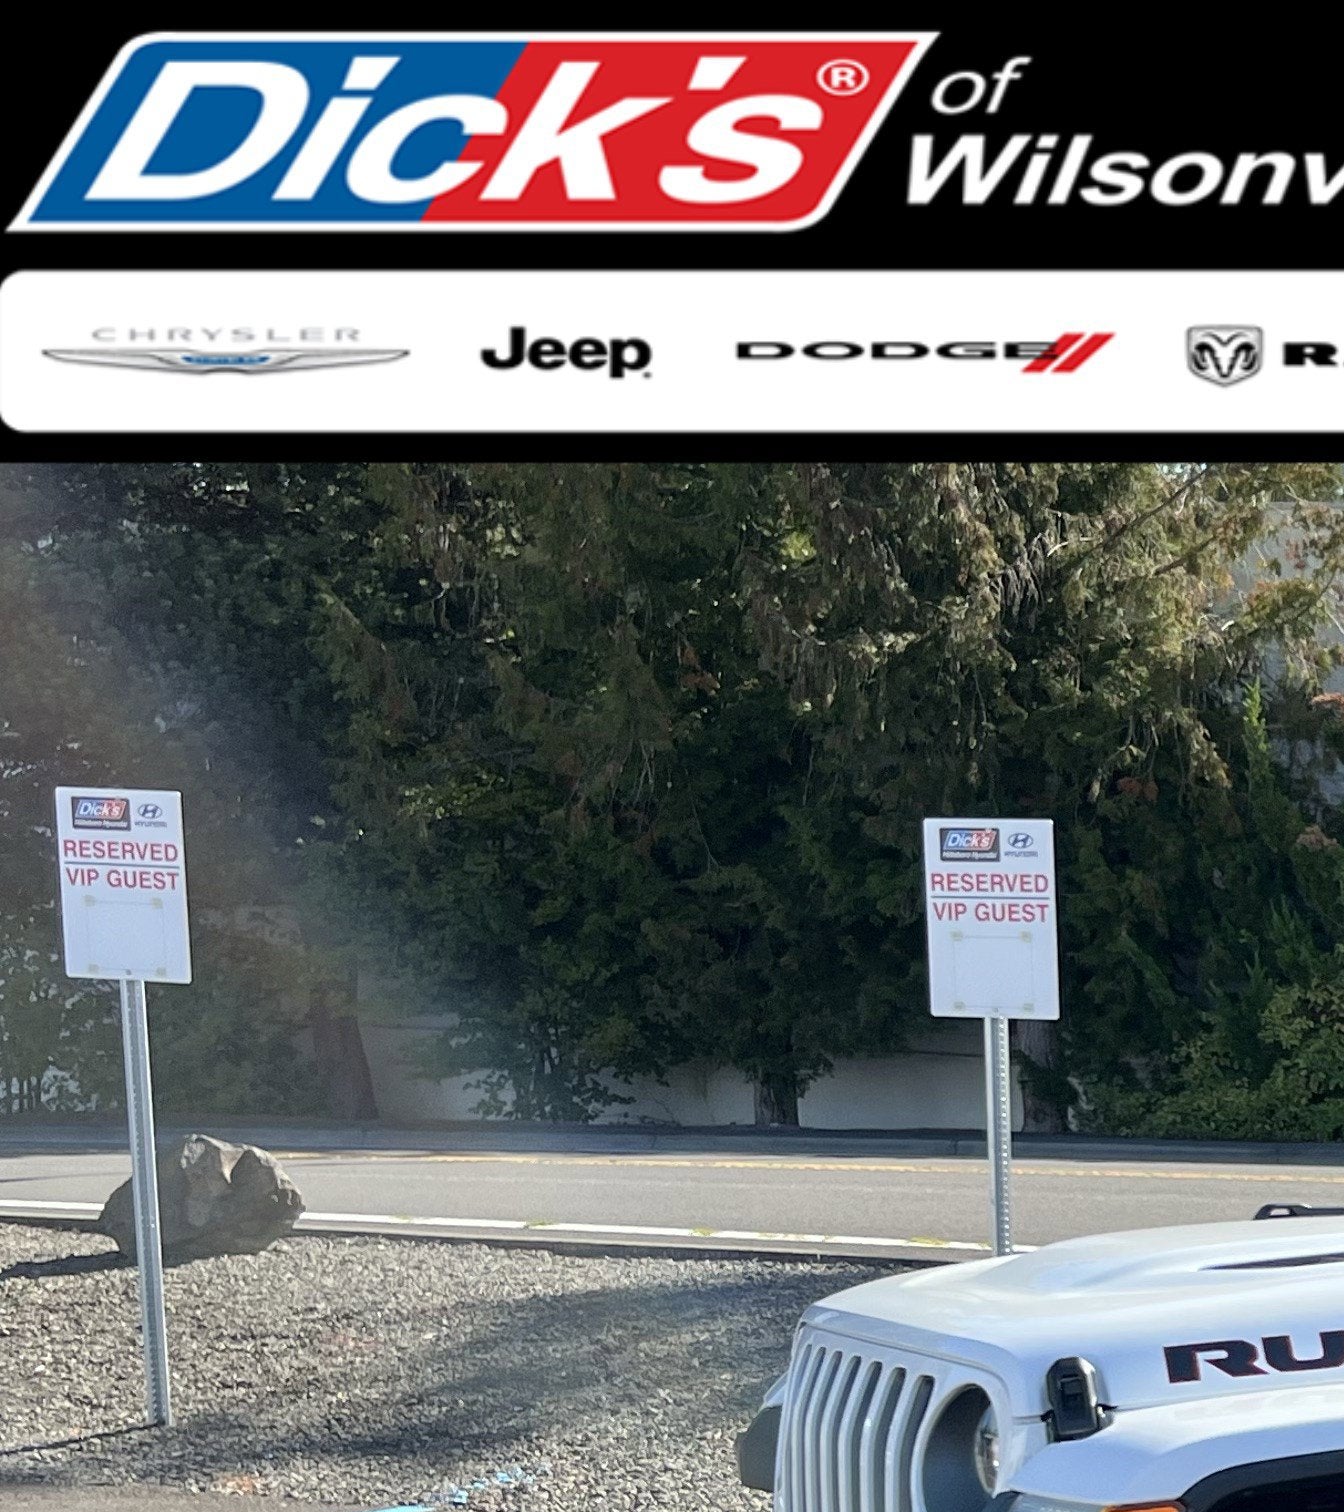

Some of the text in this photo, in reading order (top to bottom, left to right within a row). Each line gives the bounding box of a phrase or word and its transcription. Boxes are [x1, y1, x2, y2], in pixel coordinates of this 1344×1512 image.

[63, 839, 179, 862] RESERVED
[66, 867, 179, 891] VIP GUEST
[930, 873, 1049, 893] RESERVED
[933, 902, 1049, 923] VIP GUEST
